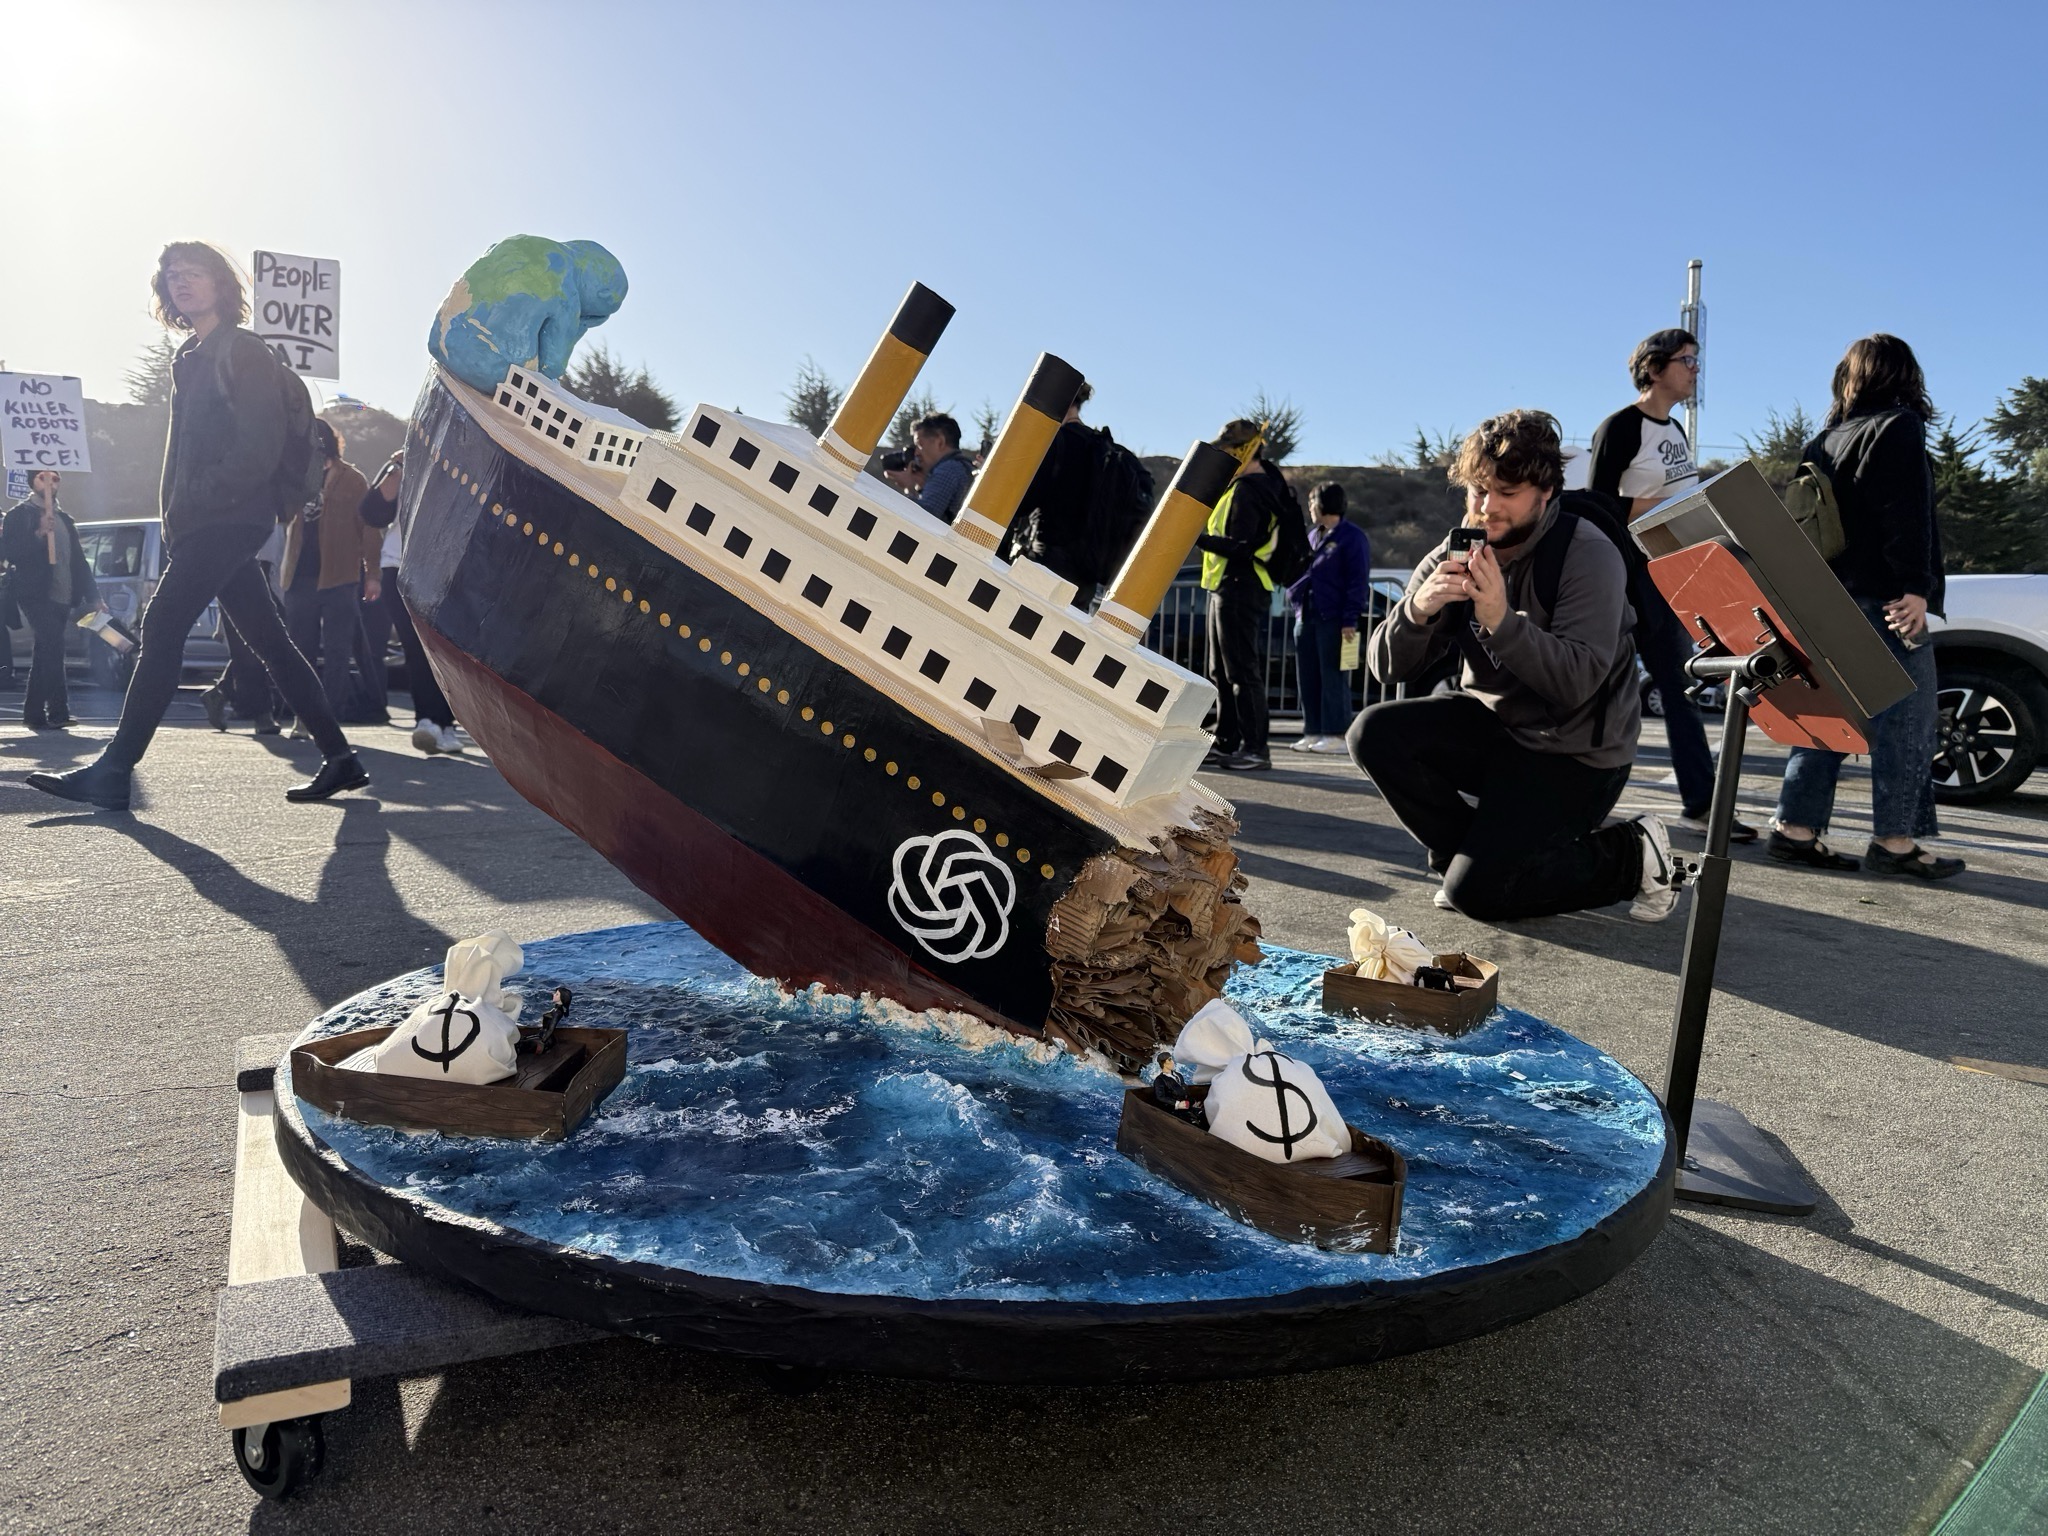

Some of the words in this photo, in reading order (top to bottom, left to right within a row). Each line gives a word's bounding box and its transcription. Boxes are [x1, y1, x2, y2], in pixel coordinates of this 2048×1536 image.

[263, 300, 333, 337] OVER
[20, 378, 52, 396] NO
[4, 399, 75, 416] KILLER
[11, 416, 79, 432] ROBOTS
[30, 431, 67, 447] FOR
[14, 448, 80, 467] ICE!
[1658, 439, 1688, 466] Bay
[1242, 1050, 1318, 1161] $
